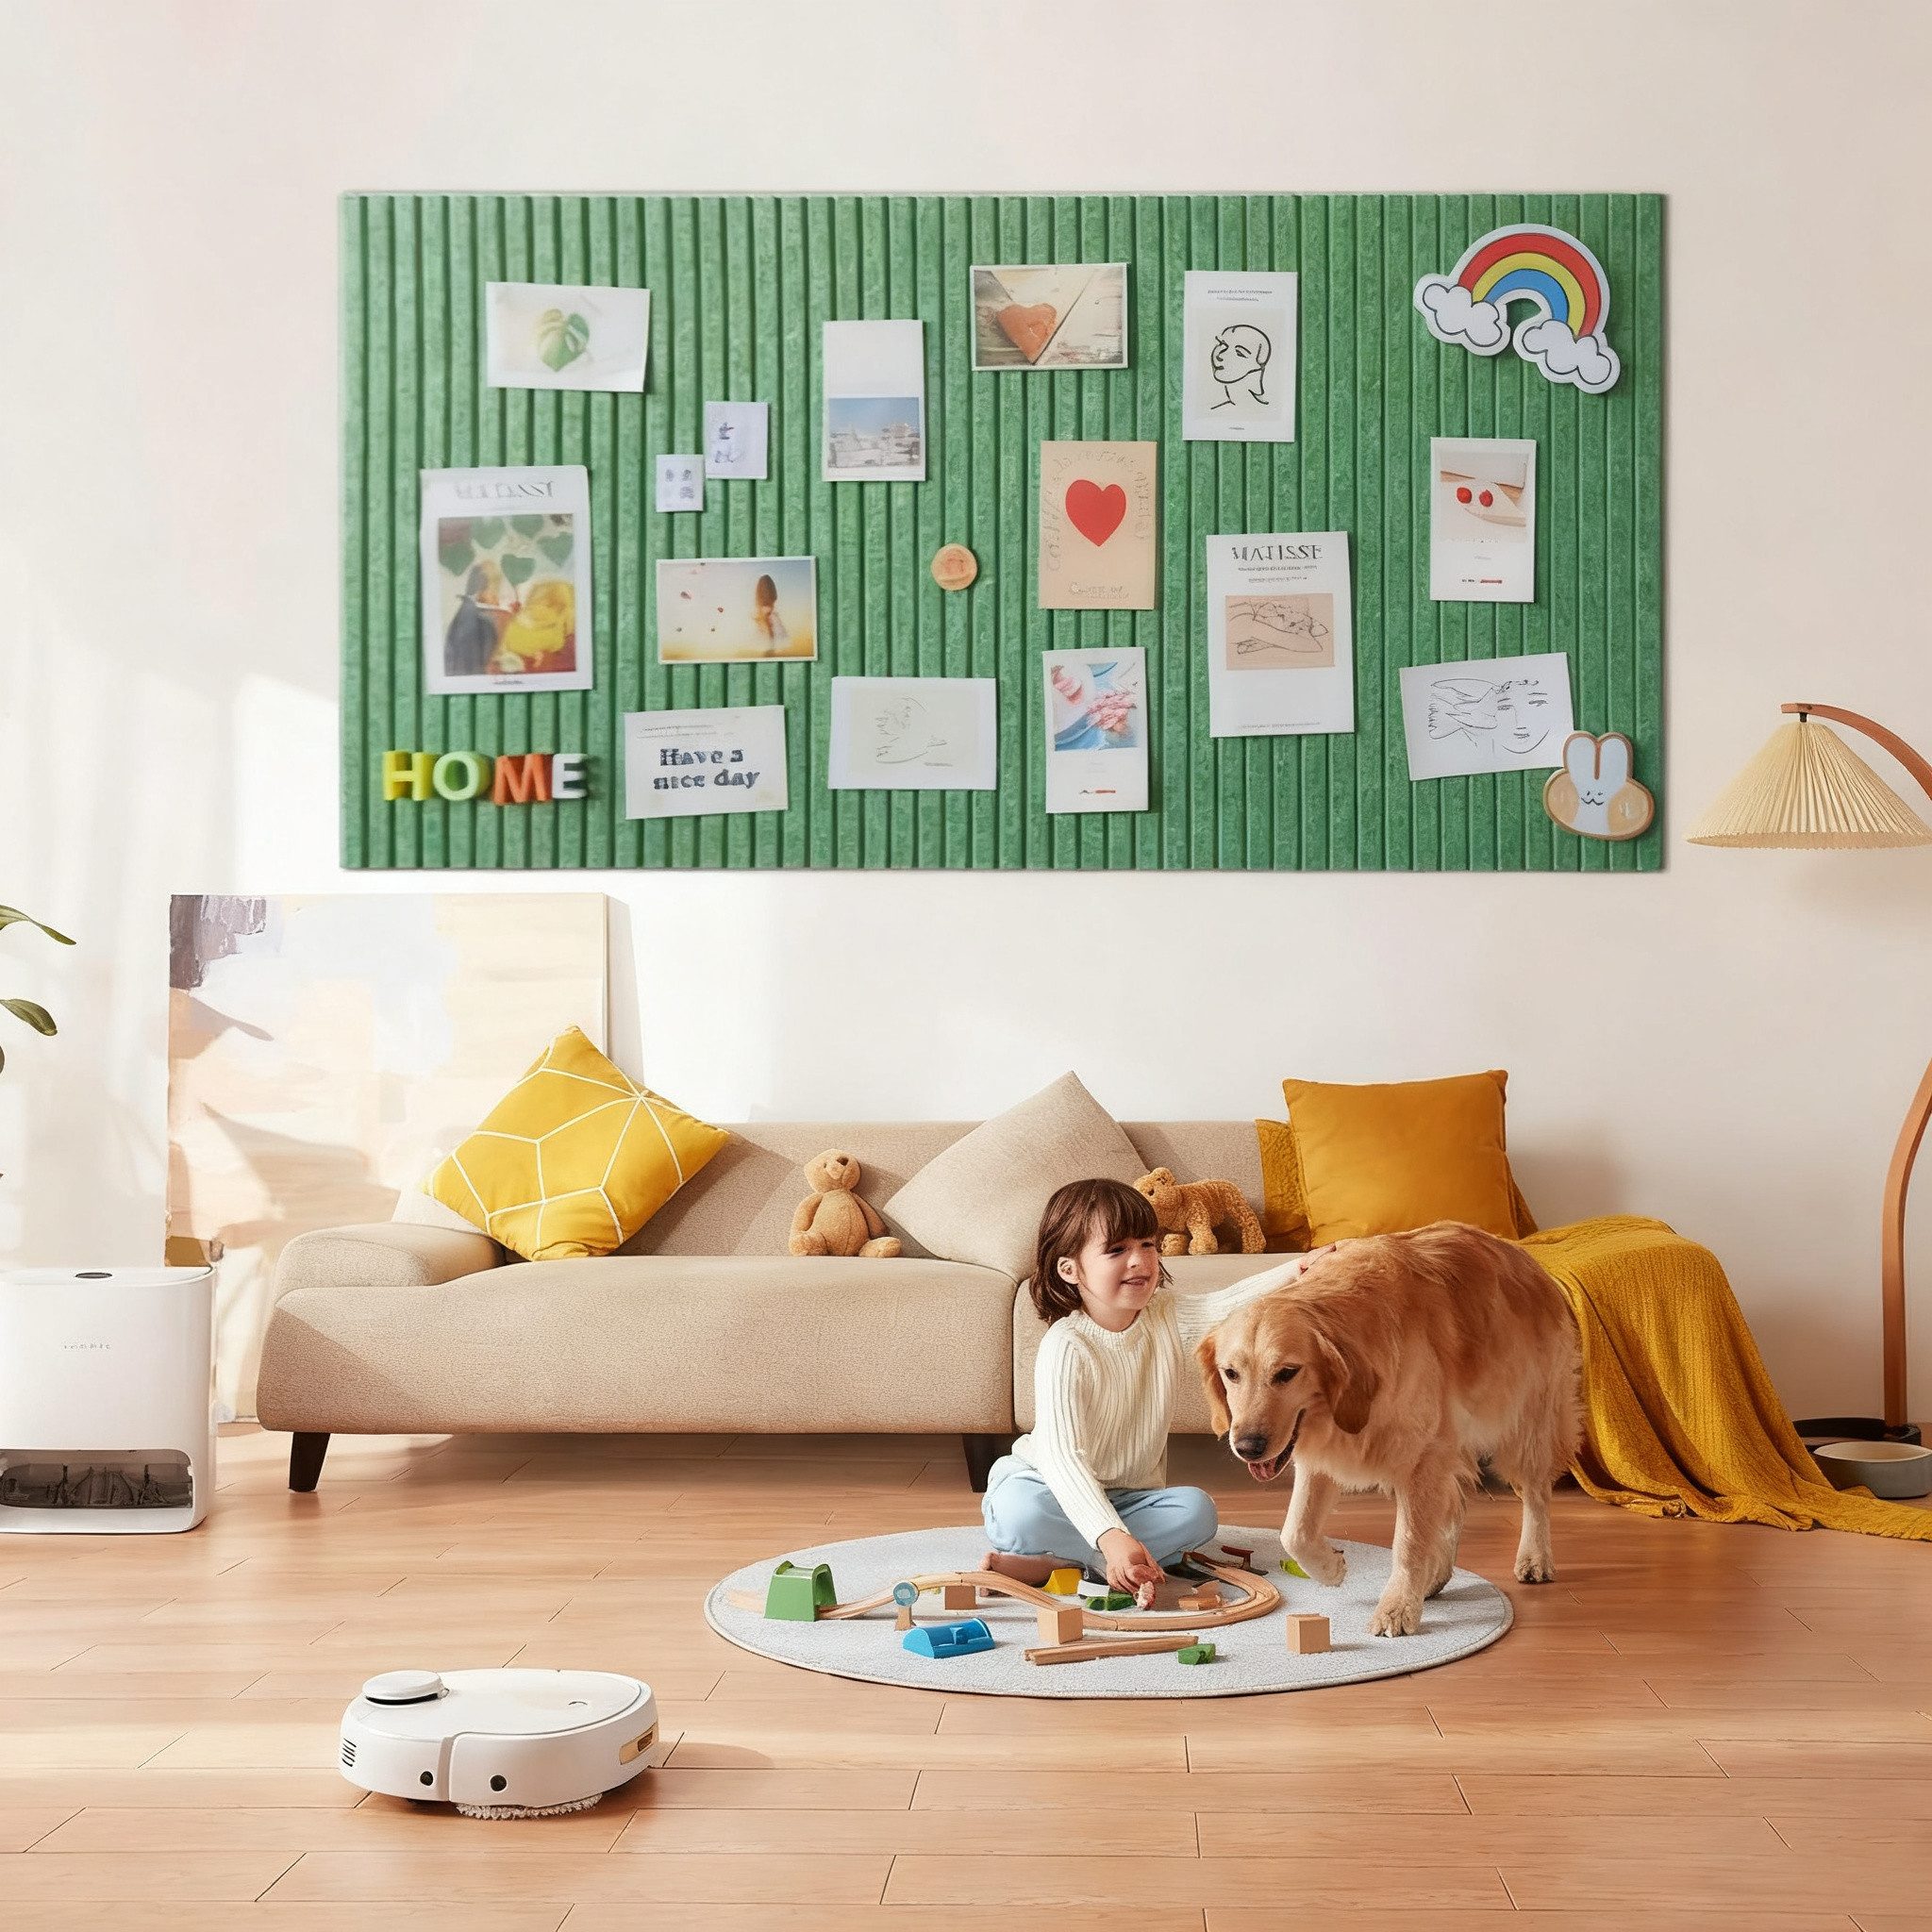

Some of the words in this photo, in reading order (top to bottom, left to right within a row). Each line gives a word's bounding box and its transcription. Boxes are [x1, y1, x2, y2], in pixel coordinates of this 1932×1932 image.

[660, 748, 724, 767] Have
[730, 748, 744, 762] a
[382, 751, 589, 806] HOME
[653, 774, 706, 790] nice
[713, 769, 760, 789] day
